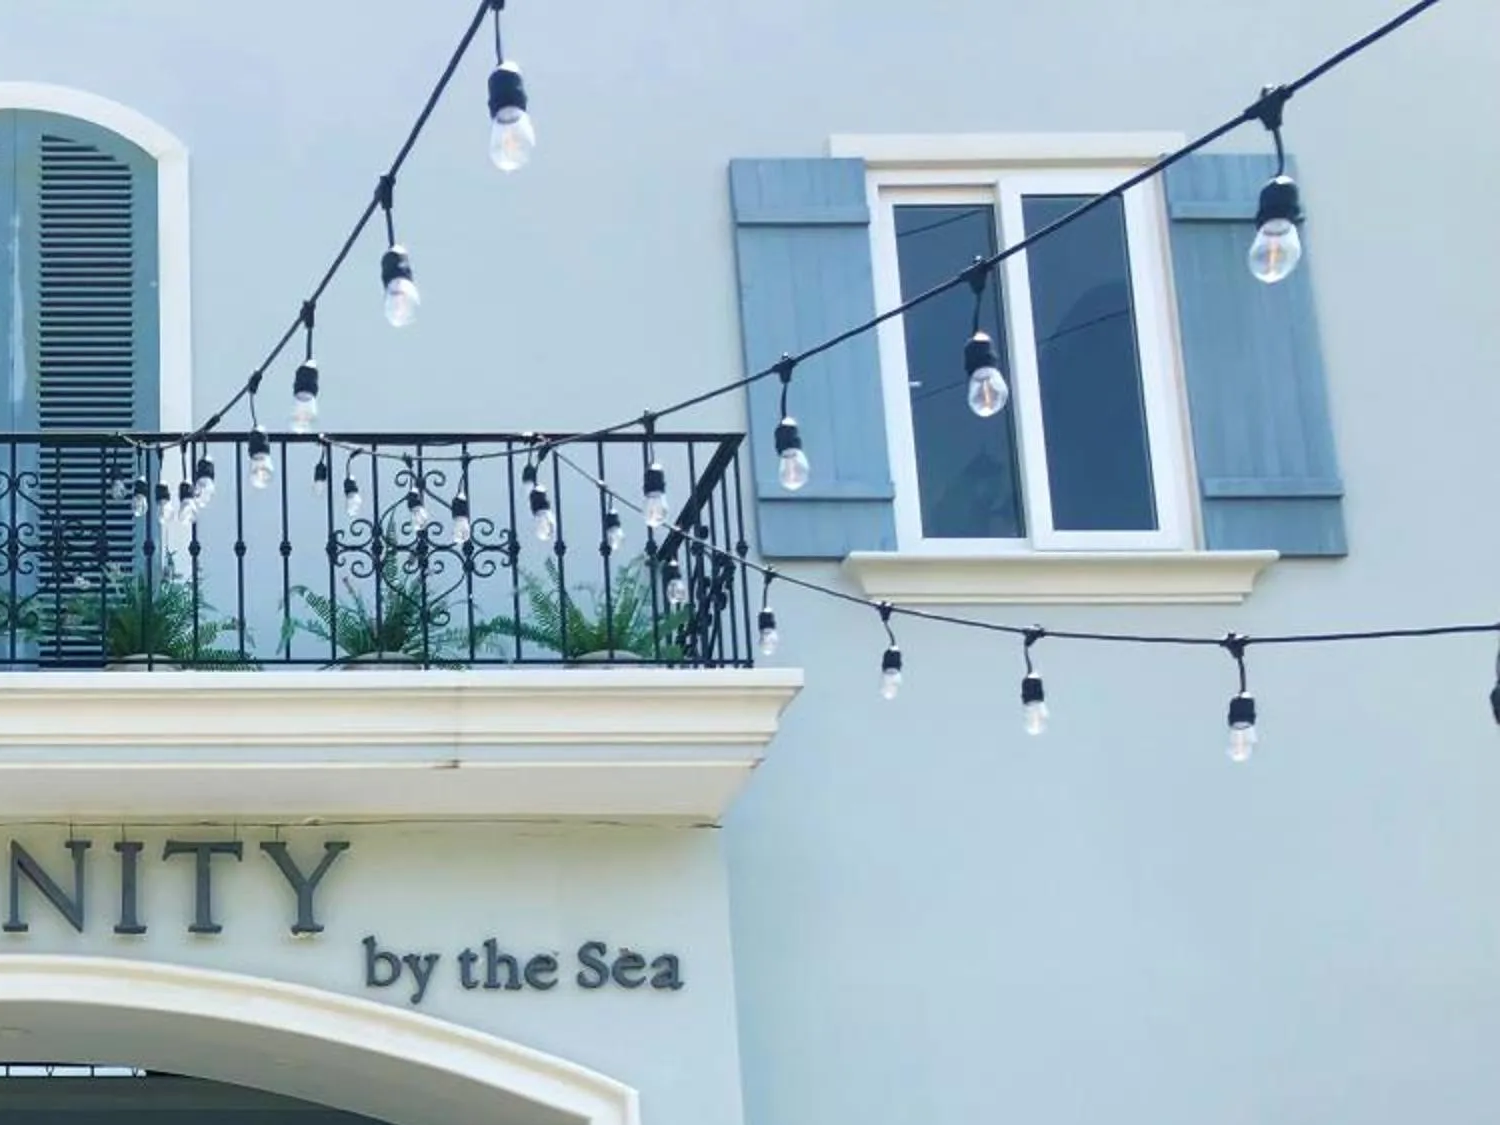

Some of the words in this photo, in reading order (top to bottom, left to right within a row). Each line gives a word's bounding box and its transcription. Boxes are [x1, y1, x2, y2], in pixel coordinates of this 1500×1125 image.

[363, 936, 438, 1004] by
[458, 938, 558, 991] the
[576, 941, 685, 991] Sea
